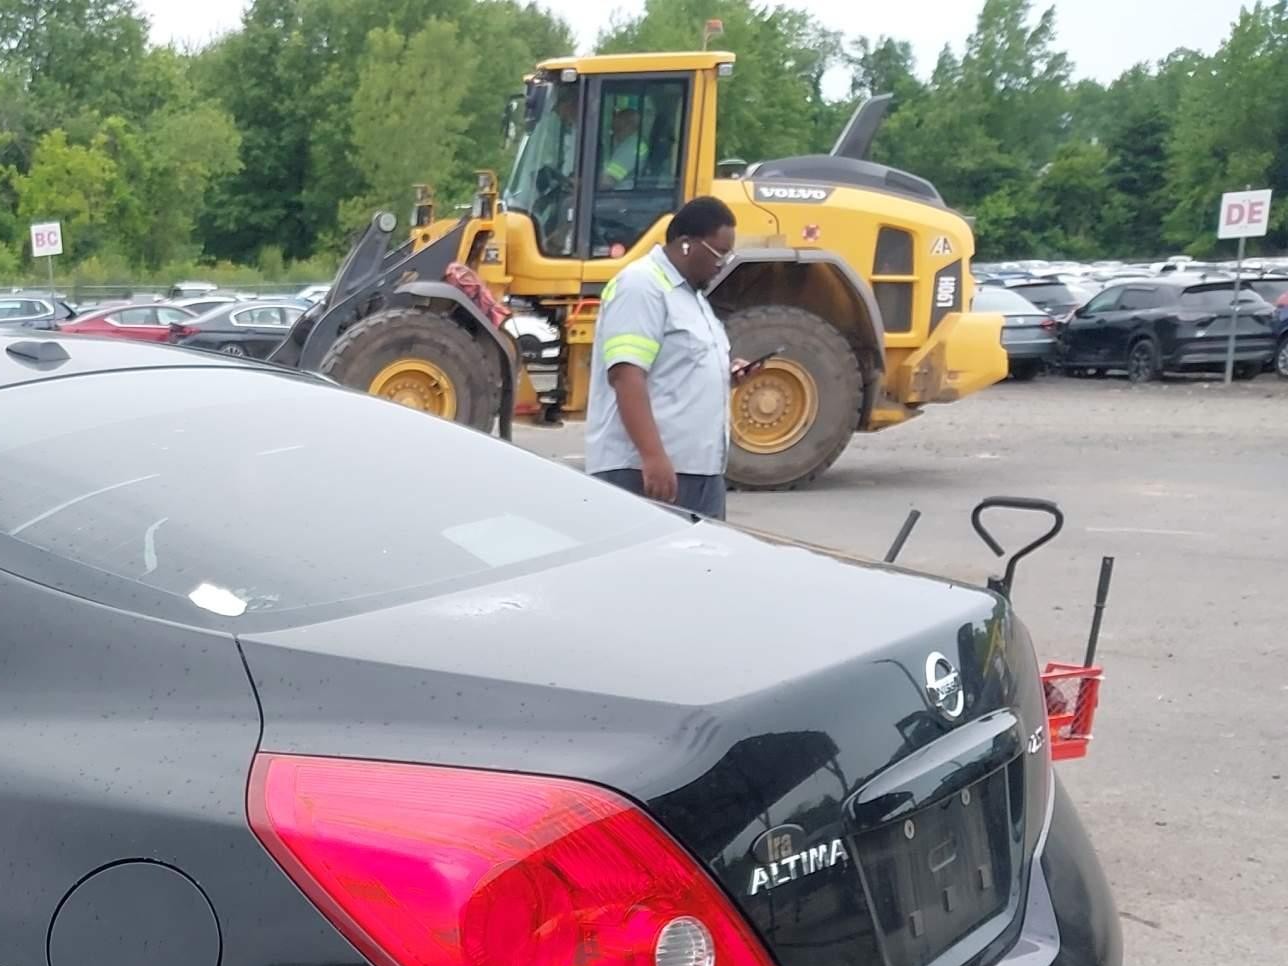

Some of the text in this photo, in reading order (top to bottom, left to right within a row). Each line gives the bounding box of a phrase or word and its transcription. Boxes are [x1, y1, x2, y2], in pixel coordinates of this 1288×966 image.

[759, 187, 827, 200] VOLVO
[1225, 201, 1264, 226] DE
[35, 231, 58, 248] BC
[936, 276, 956, 308] L90H
[748, 839, 849, 896] ALTIMA
